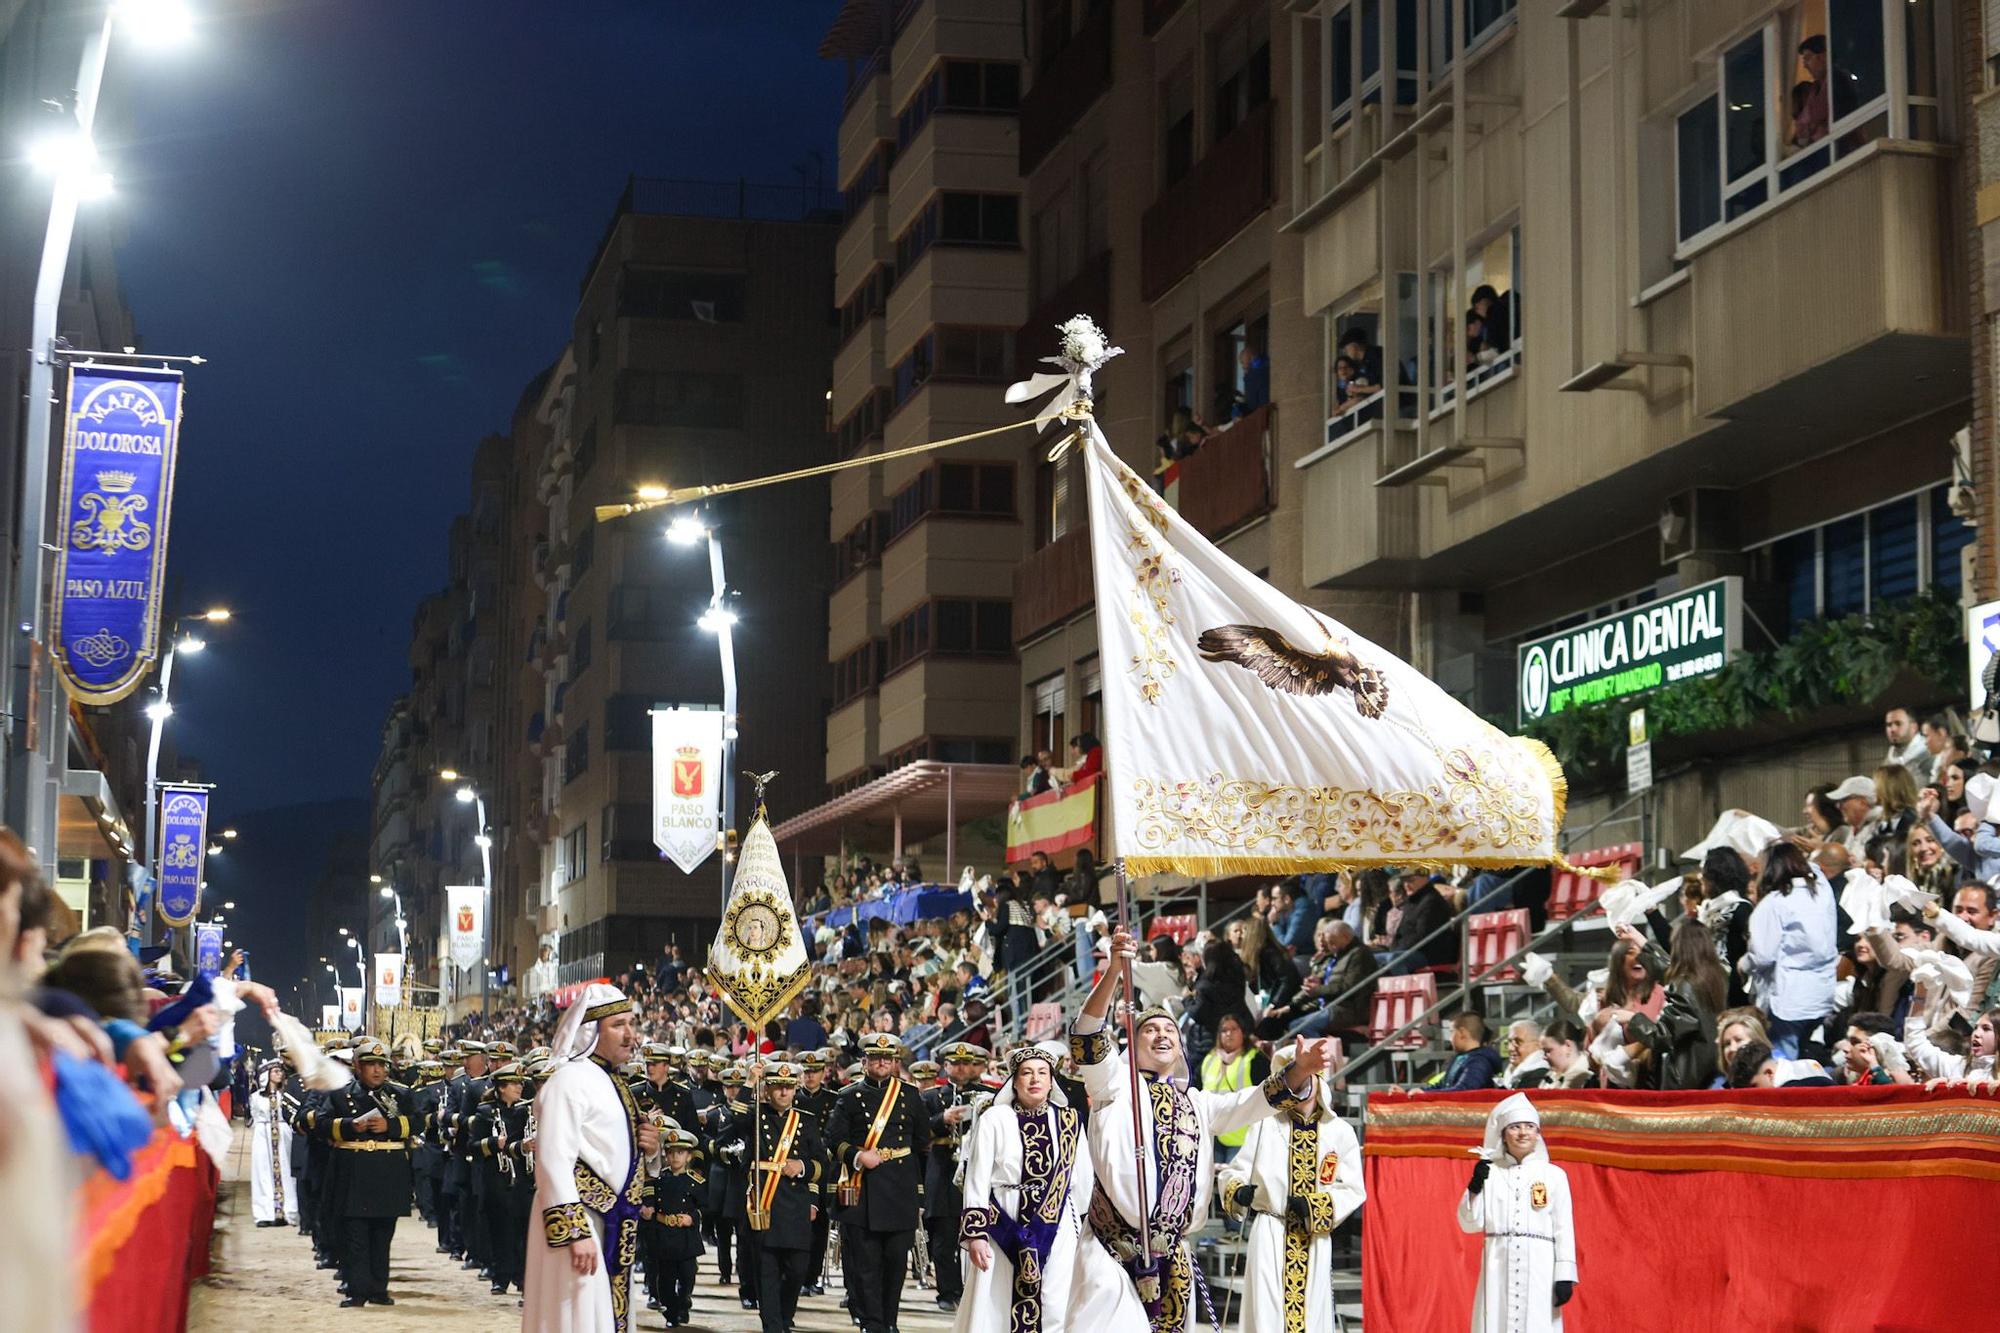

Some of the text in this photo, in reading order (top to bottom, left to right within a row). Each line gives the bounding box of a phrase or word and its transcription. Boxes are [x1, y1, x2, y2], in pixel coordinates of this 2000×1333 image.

[88, 392, 160, 428] MATER
[76, 431, 163, 455] DOLOROSA
[66, 579, 147, 601] PASO AZUL
[1550, 590, 1723, 684] CLINICA DENTAL
[671, 804, 704, 816] PASO
[166, 815, 202, 827] DOLOROSA
[662, 816, 712, 829] BLANCO
[179, 875, 197, 885] AZUL
